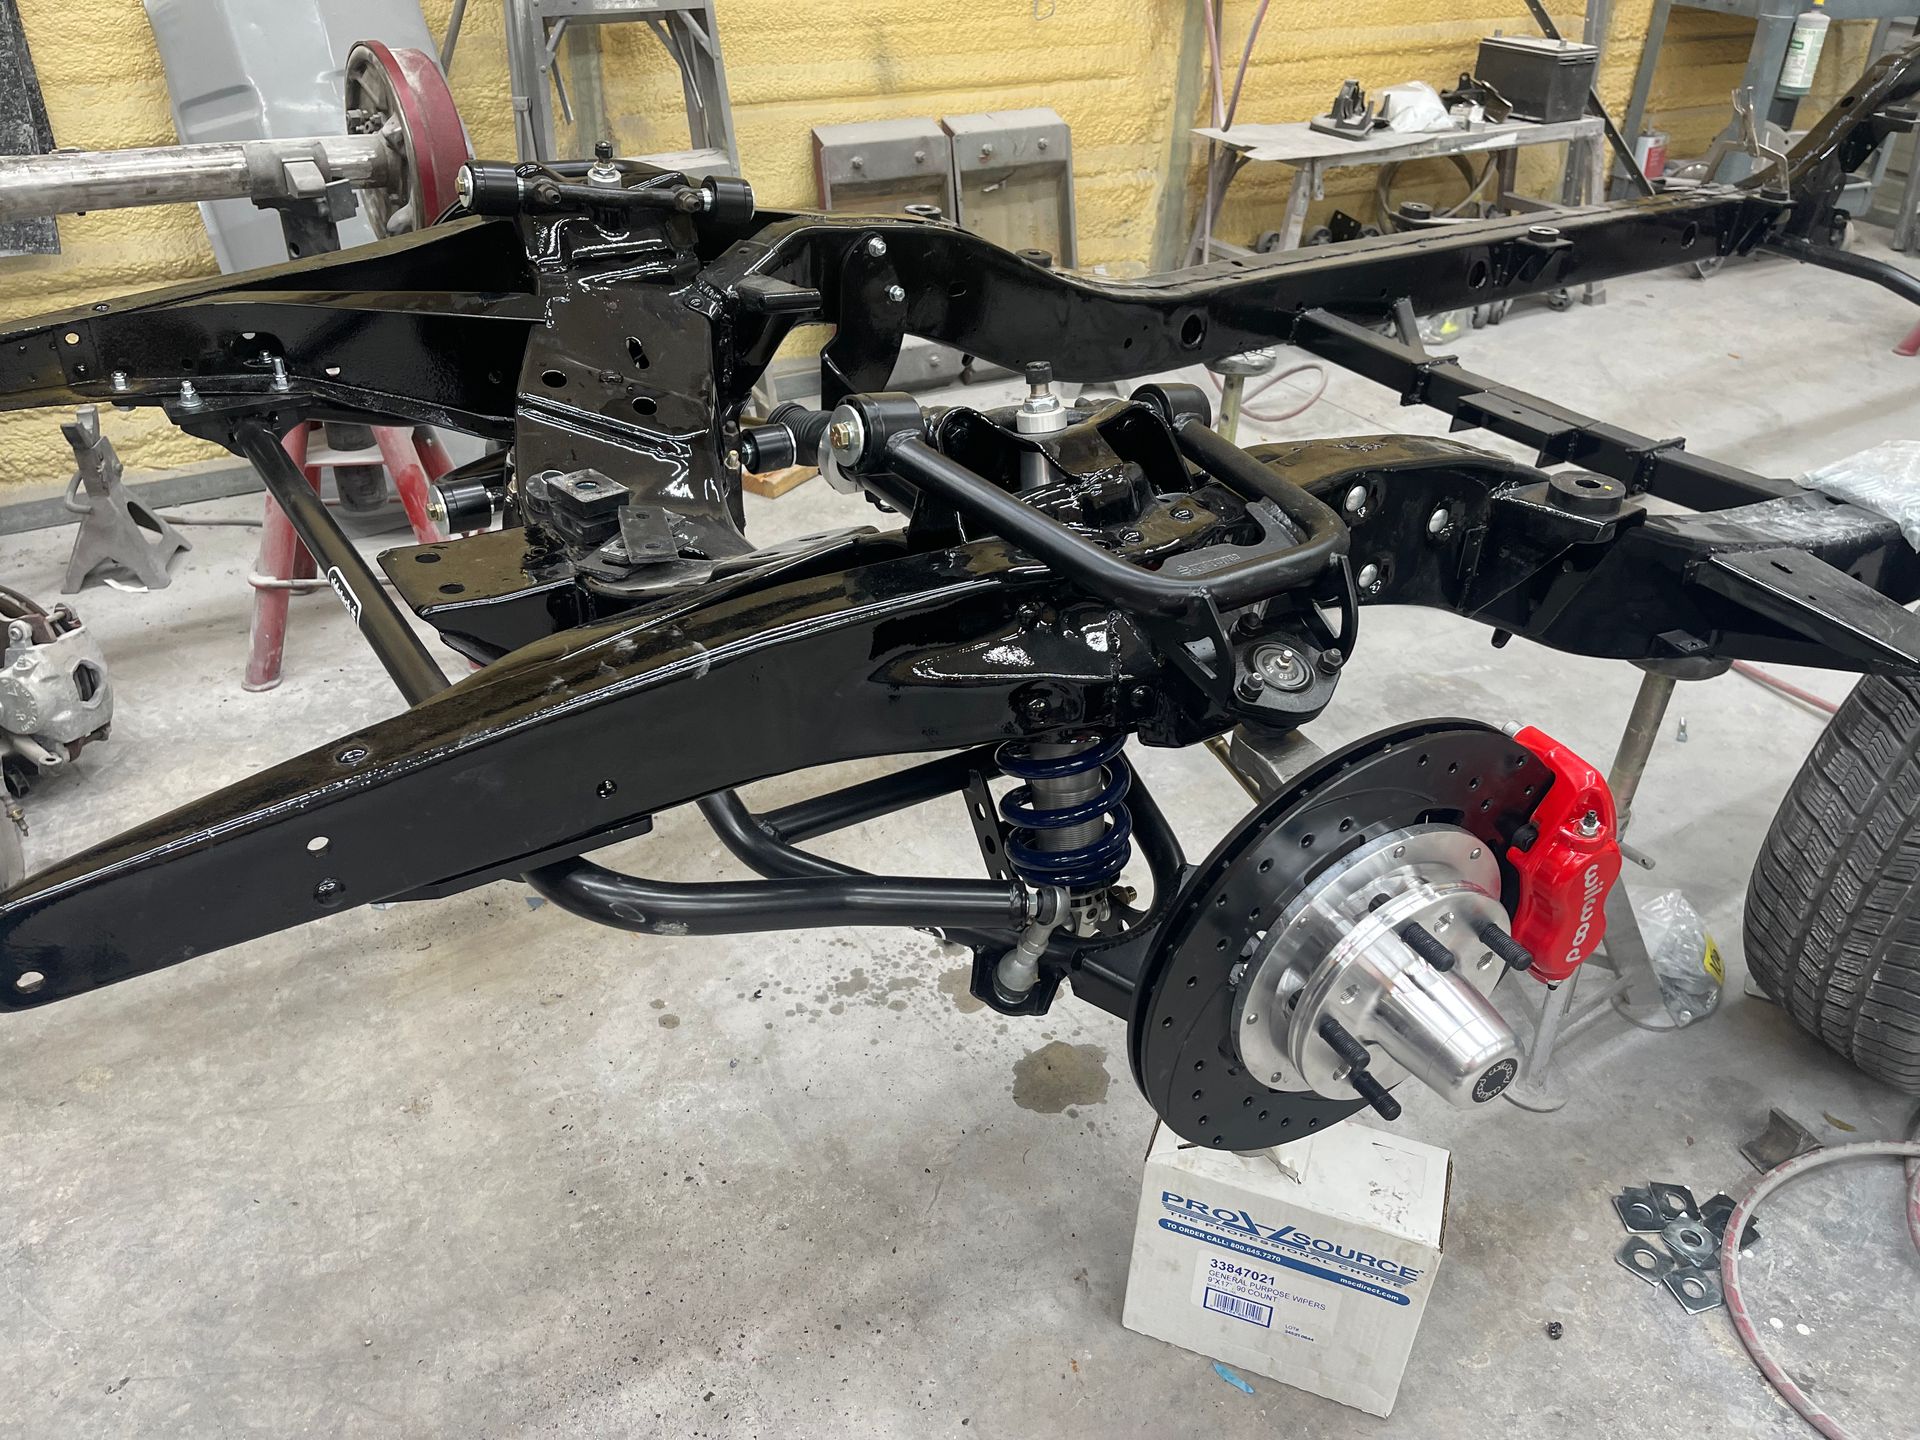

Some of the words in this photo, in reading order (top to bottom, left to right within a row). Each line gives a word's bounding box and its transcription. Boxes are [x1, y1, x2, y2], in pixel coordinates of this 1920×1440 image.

[1565, 864, 1604, 962] wilwood
[1161, 1191, 1240, 1223] PRO
[1292, 1232, 1418, 1280] SOURCE
[1168, 1212, 1198, 1224] THE
[1205, 1223, 1329, 1265] PROFESSIONAL
[1338, 1264, 1404, 1288] CHOICE
[1178, 1225, 1205, 1238] ORDER
[1208, 1232, 1229, 1246] CALL:
[1231, 1241, 1281, 1263] 800.645.7270
[1208, 1269, 1247, 1286] GENERAL
[1250, 1281, 1290, 1300] PURPOSE
[1292, 1295, 1326, 1311] WIPERS
[1210, 1258, 1276, 1286] 33847021
[1340, 1276, 1399, 1301] mscdirect.com
[1236, 1285, 1246, 1293] 90
[1248, 1288, 1278, 1303] COUNT
